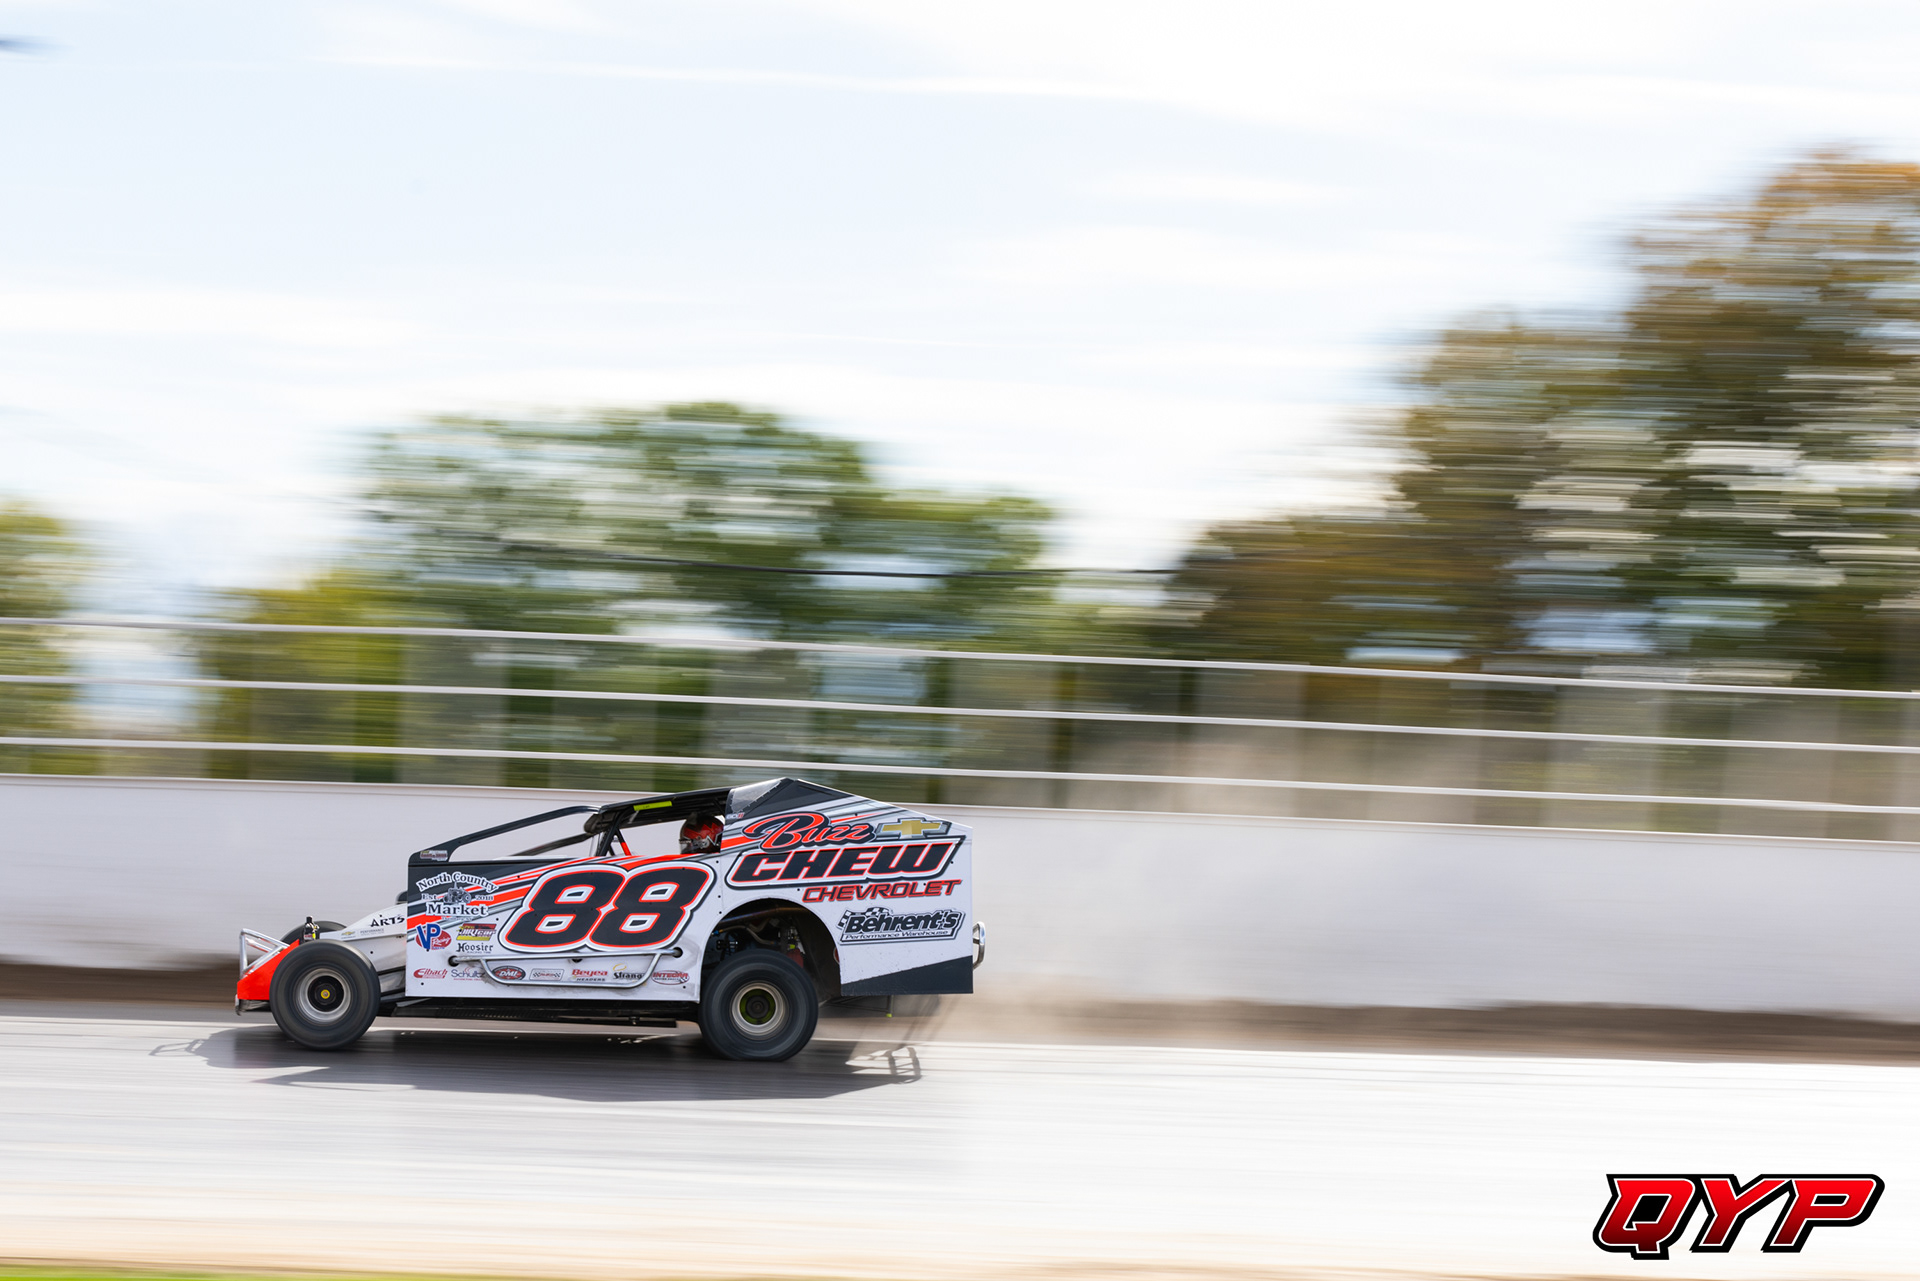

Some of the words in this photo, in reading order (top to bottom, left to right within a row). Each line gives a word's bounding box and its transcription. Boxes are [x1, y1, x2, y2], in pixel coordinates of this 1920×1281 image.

[742, 811, 875, 852] Buzz
[728, 842, 956, 885] CHEW
[416, 872, 452, 891] North
[452, 872, 499, 893] Country
[802, 879, 962, 903] CHEVROLET
[426, 902, 488, 916] Market
[502, 864, 713, 950] 88
[845, 909, 960, 934] Behrent's
[416, 923, 441, 951] VP
[456, 942, 494, 952] Hoosier
[413, 968, 448, 979] Eibach
[572, 969, 608, 977] Beyea
[613, 972, 648, 980] Strang
